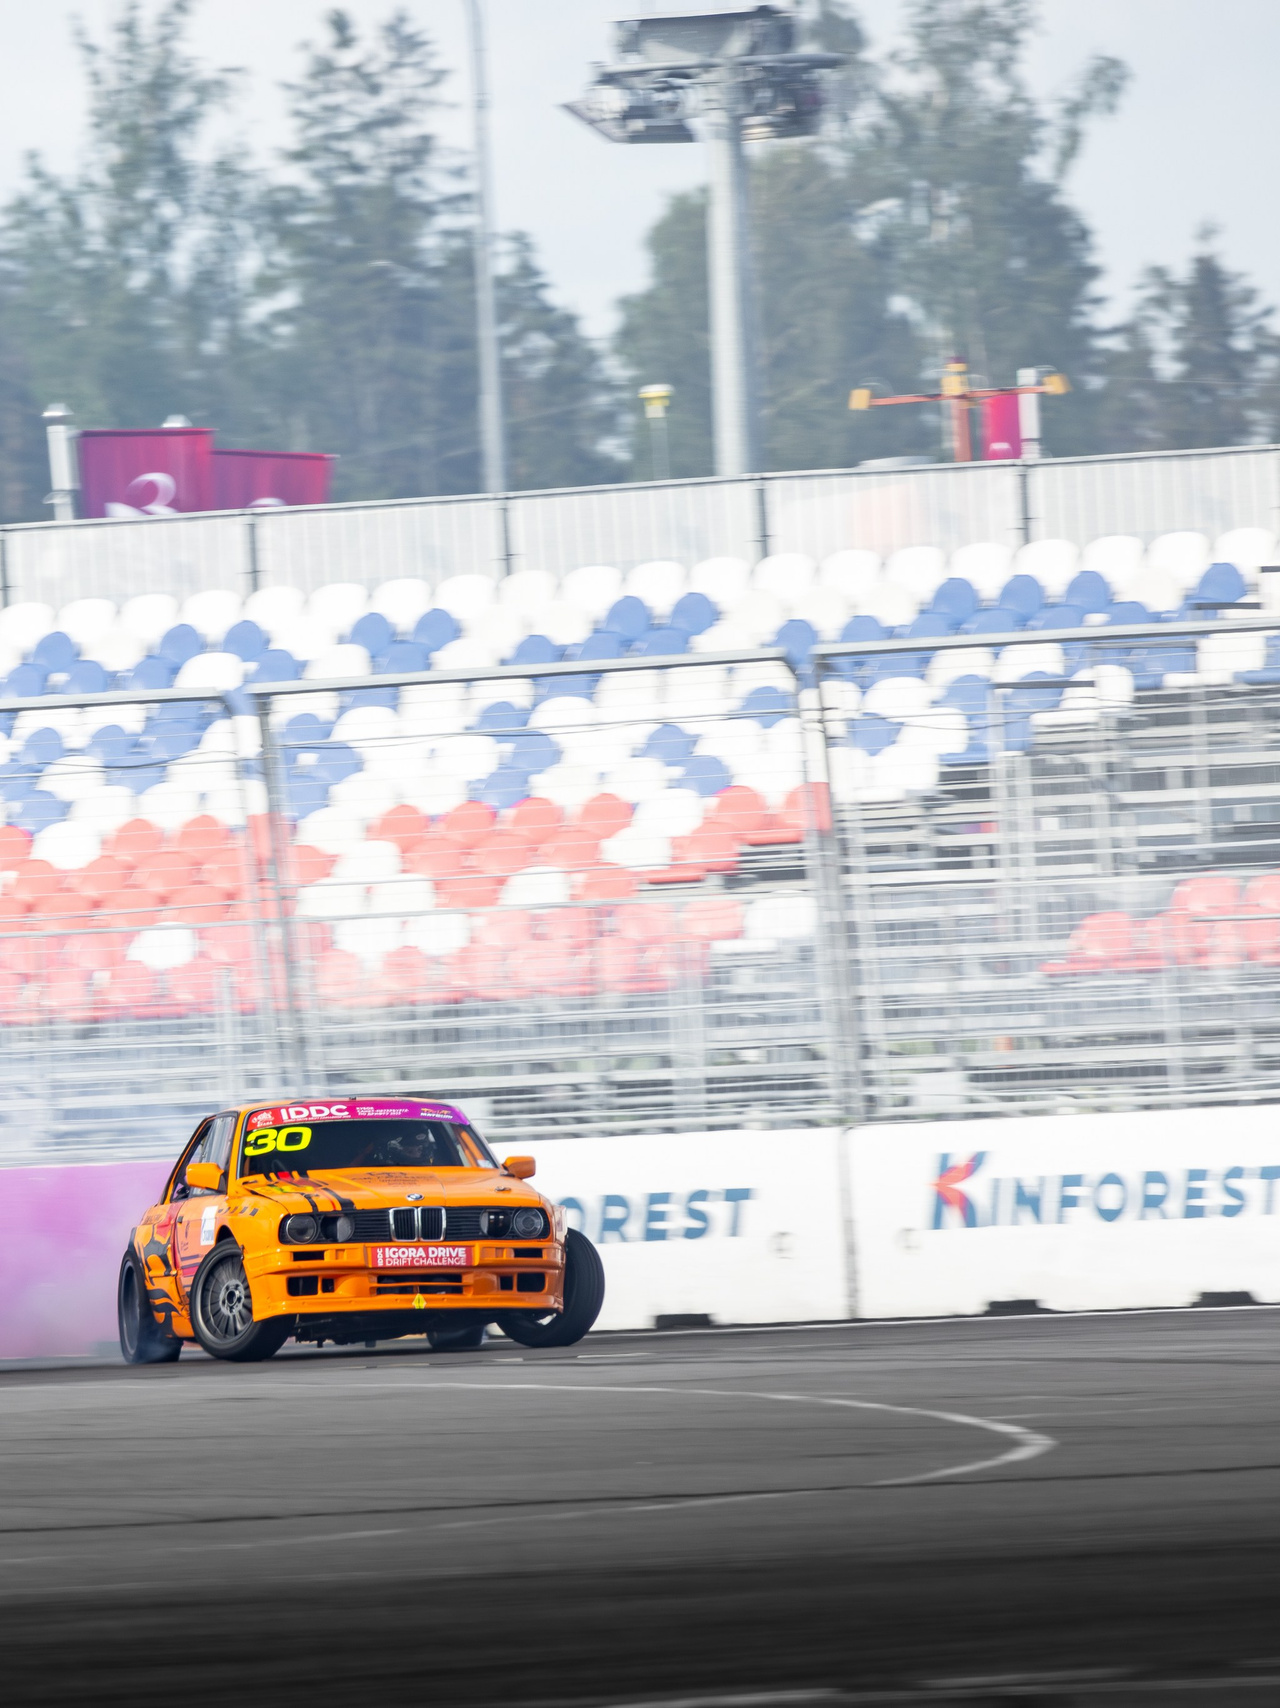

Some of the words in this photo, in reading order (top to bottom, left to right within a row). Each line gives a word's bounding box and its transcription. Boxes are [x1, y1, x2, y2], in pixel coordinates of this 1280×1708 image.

[280, 1104, 349, 1120] IDDC
[244, 1126, 312, 1156] 30
[930, 1151, 1280, 1230] KINFOREST
[385, 1247, 426, 1258] IGORA
[428, 1247, 466, 1258] DRIVE
[385, 1258, 412, 1266] DRIFT
[414, 1258, 466, 1266] CHALLENGE
